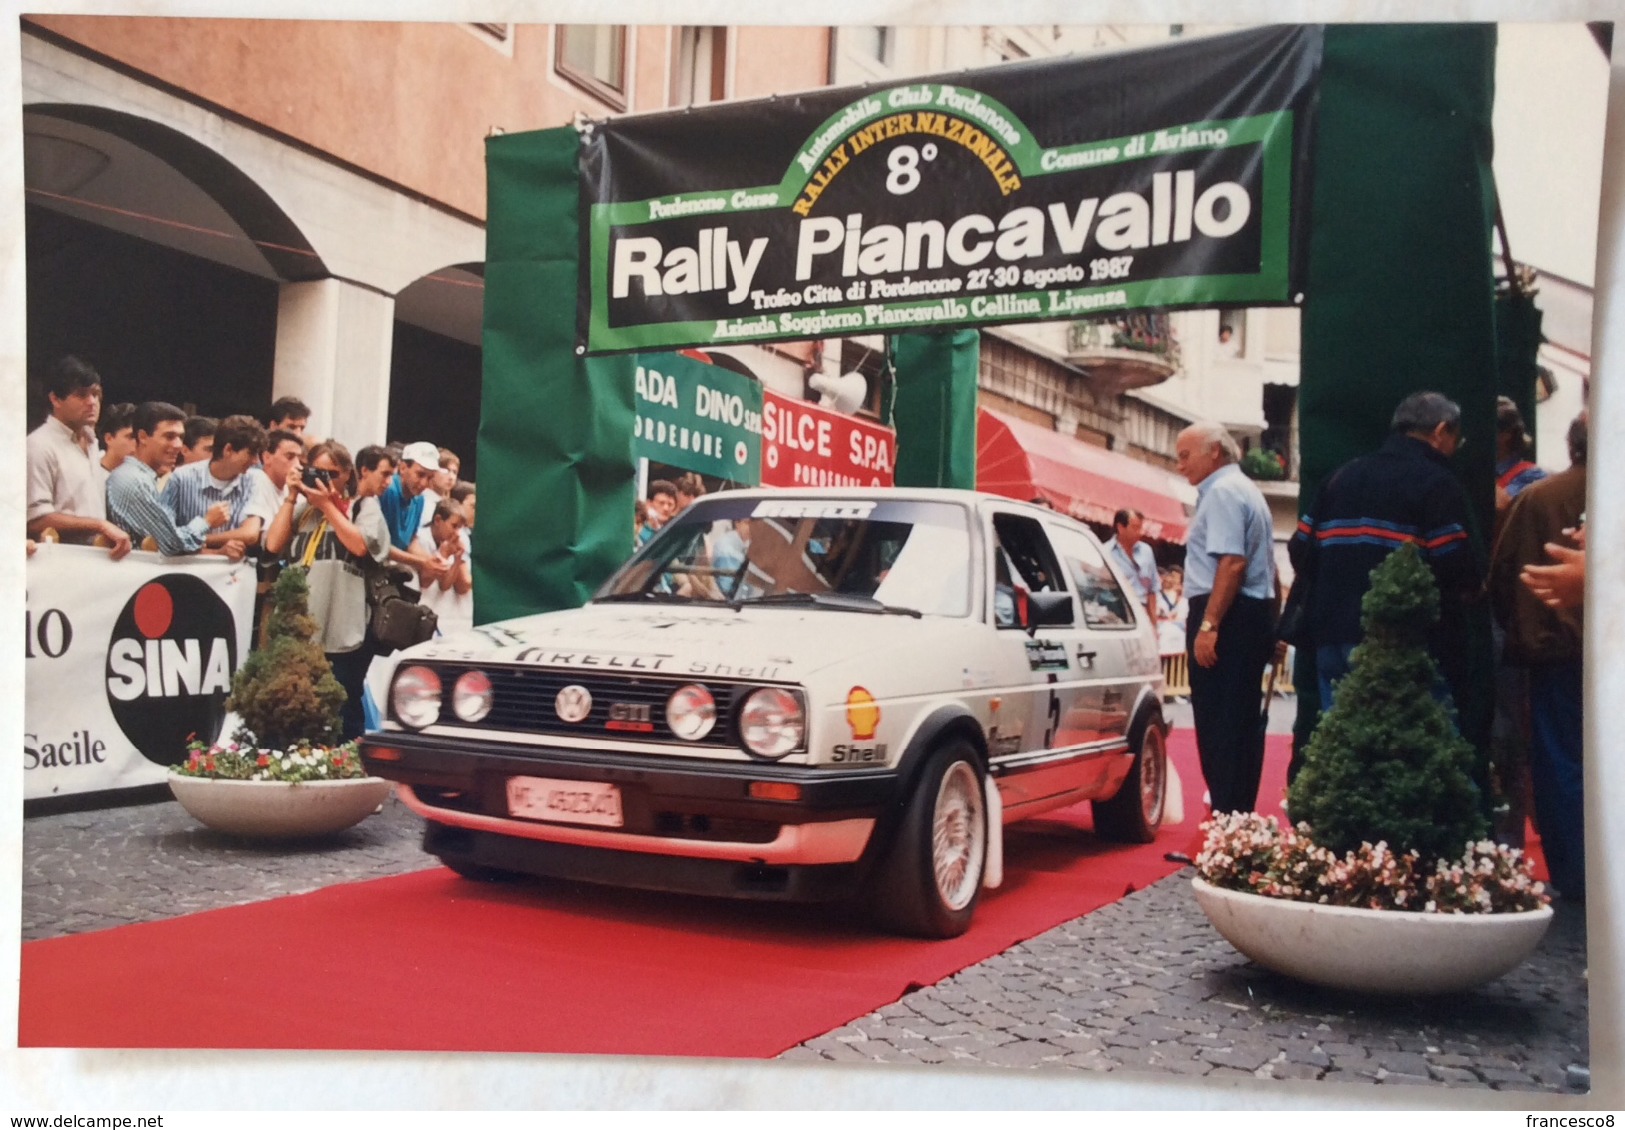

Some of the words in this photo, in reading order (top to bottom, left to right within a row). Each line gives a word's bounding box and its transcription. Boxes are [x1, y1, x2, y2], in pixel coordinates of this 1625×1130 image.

[798, 99, 881, 173] Automobile
[889, 85, 932, 107] Club
[936, 86, 1020, 145] Pordenone
[1041, 148, 1119, 171] Comune
[1124, 135, 1145, 157] di
[1151, 126, 1228, 152] Aviano
[792, 144, 849, 216] RALLY
[849, 112, 1021, 196] INTERNAZIONALE
[649, 196, 726, 219] Pordenone
[731, 190, 778, 209] Corse
[612, 227, 769, 304] Rally
[796, 170, 1250, 281] Piancavallo
[751, 289, 801, 309] Trofeo
[847, 280, 867, 300] di
[869, 277, 962, 298] Pordenone
[1023, 264, 1084, 289] agosto
[1090, 256, 1133, 280] 1987
[713, 315, 777, 338] Azienda
[780, 309, 862, 334] Soggiorno
[864, 298, 967, 325] Piancavallo
[971, 294, 1040, 317] Cellina
[1048, 290, 1126, 312] Livenza
[695, 384, 743, 427] DINO
[764, 401, 831, 457] SILCE
[24, 730, 106, 770] Sacile
[832, 744, 886, 762] Shell
